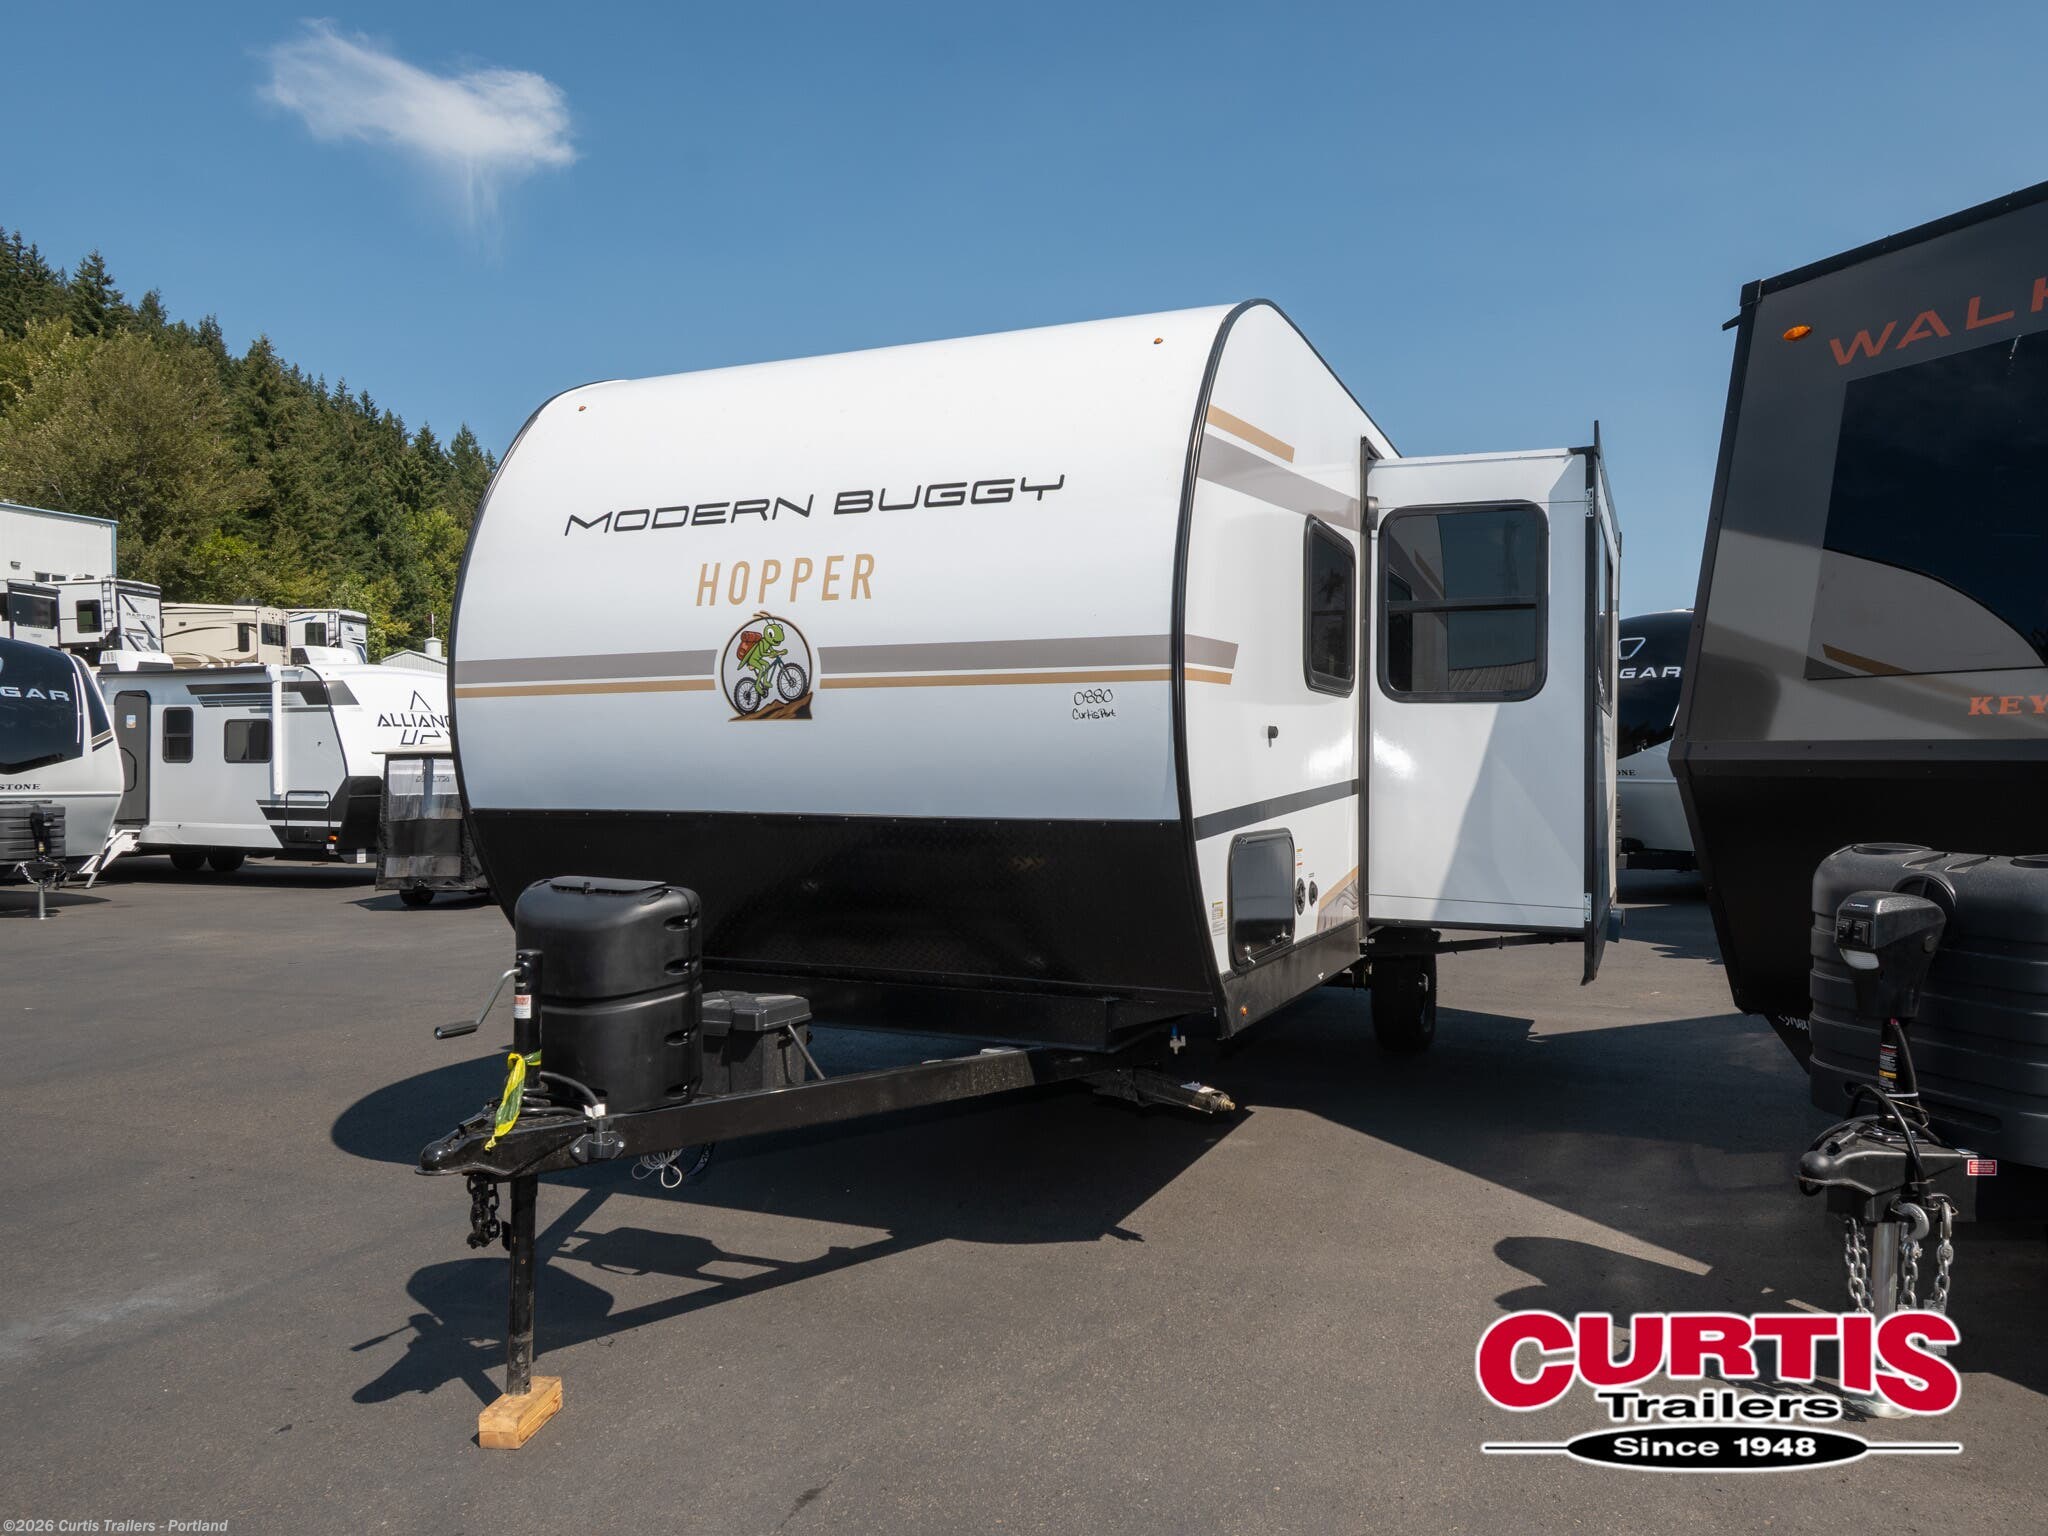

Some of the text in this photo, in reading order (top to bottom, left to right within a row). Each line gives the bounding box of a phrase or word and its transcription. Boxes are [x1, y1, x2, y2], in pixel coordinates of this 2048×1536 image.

[564, 474, 1066, 537] MODERN BUGGY
[696, 553, 876, 607] HOPPER
[1074, 688, 1113, 706] 0880
[1968, 695, 2048, 715] KEY
